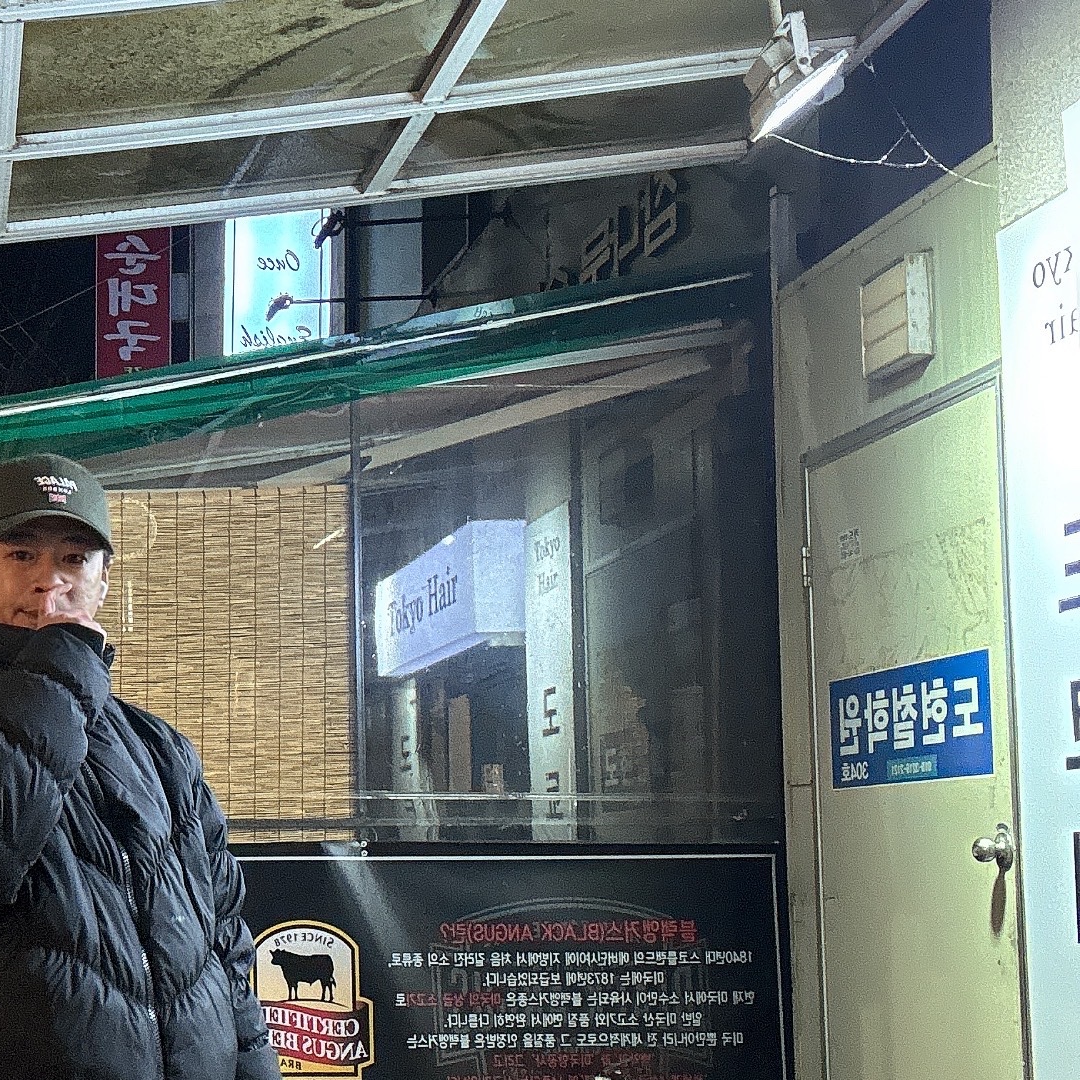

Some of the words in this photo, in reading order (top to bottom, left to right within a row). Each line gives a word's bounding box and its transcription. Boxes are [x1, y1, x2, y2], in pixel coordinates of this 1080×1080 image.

[532, 535, 561, 564] Tokyo
[536, 567, 559, 597] Hair
[387, 591, 424, 638] Tokyo
[424, 565, 459, 617] Hair
